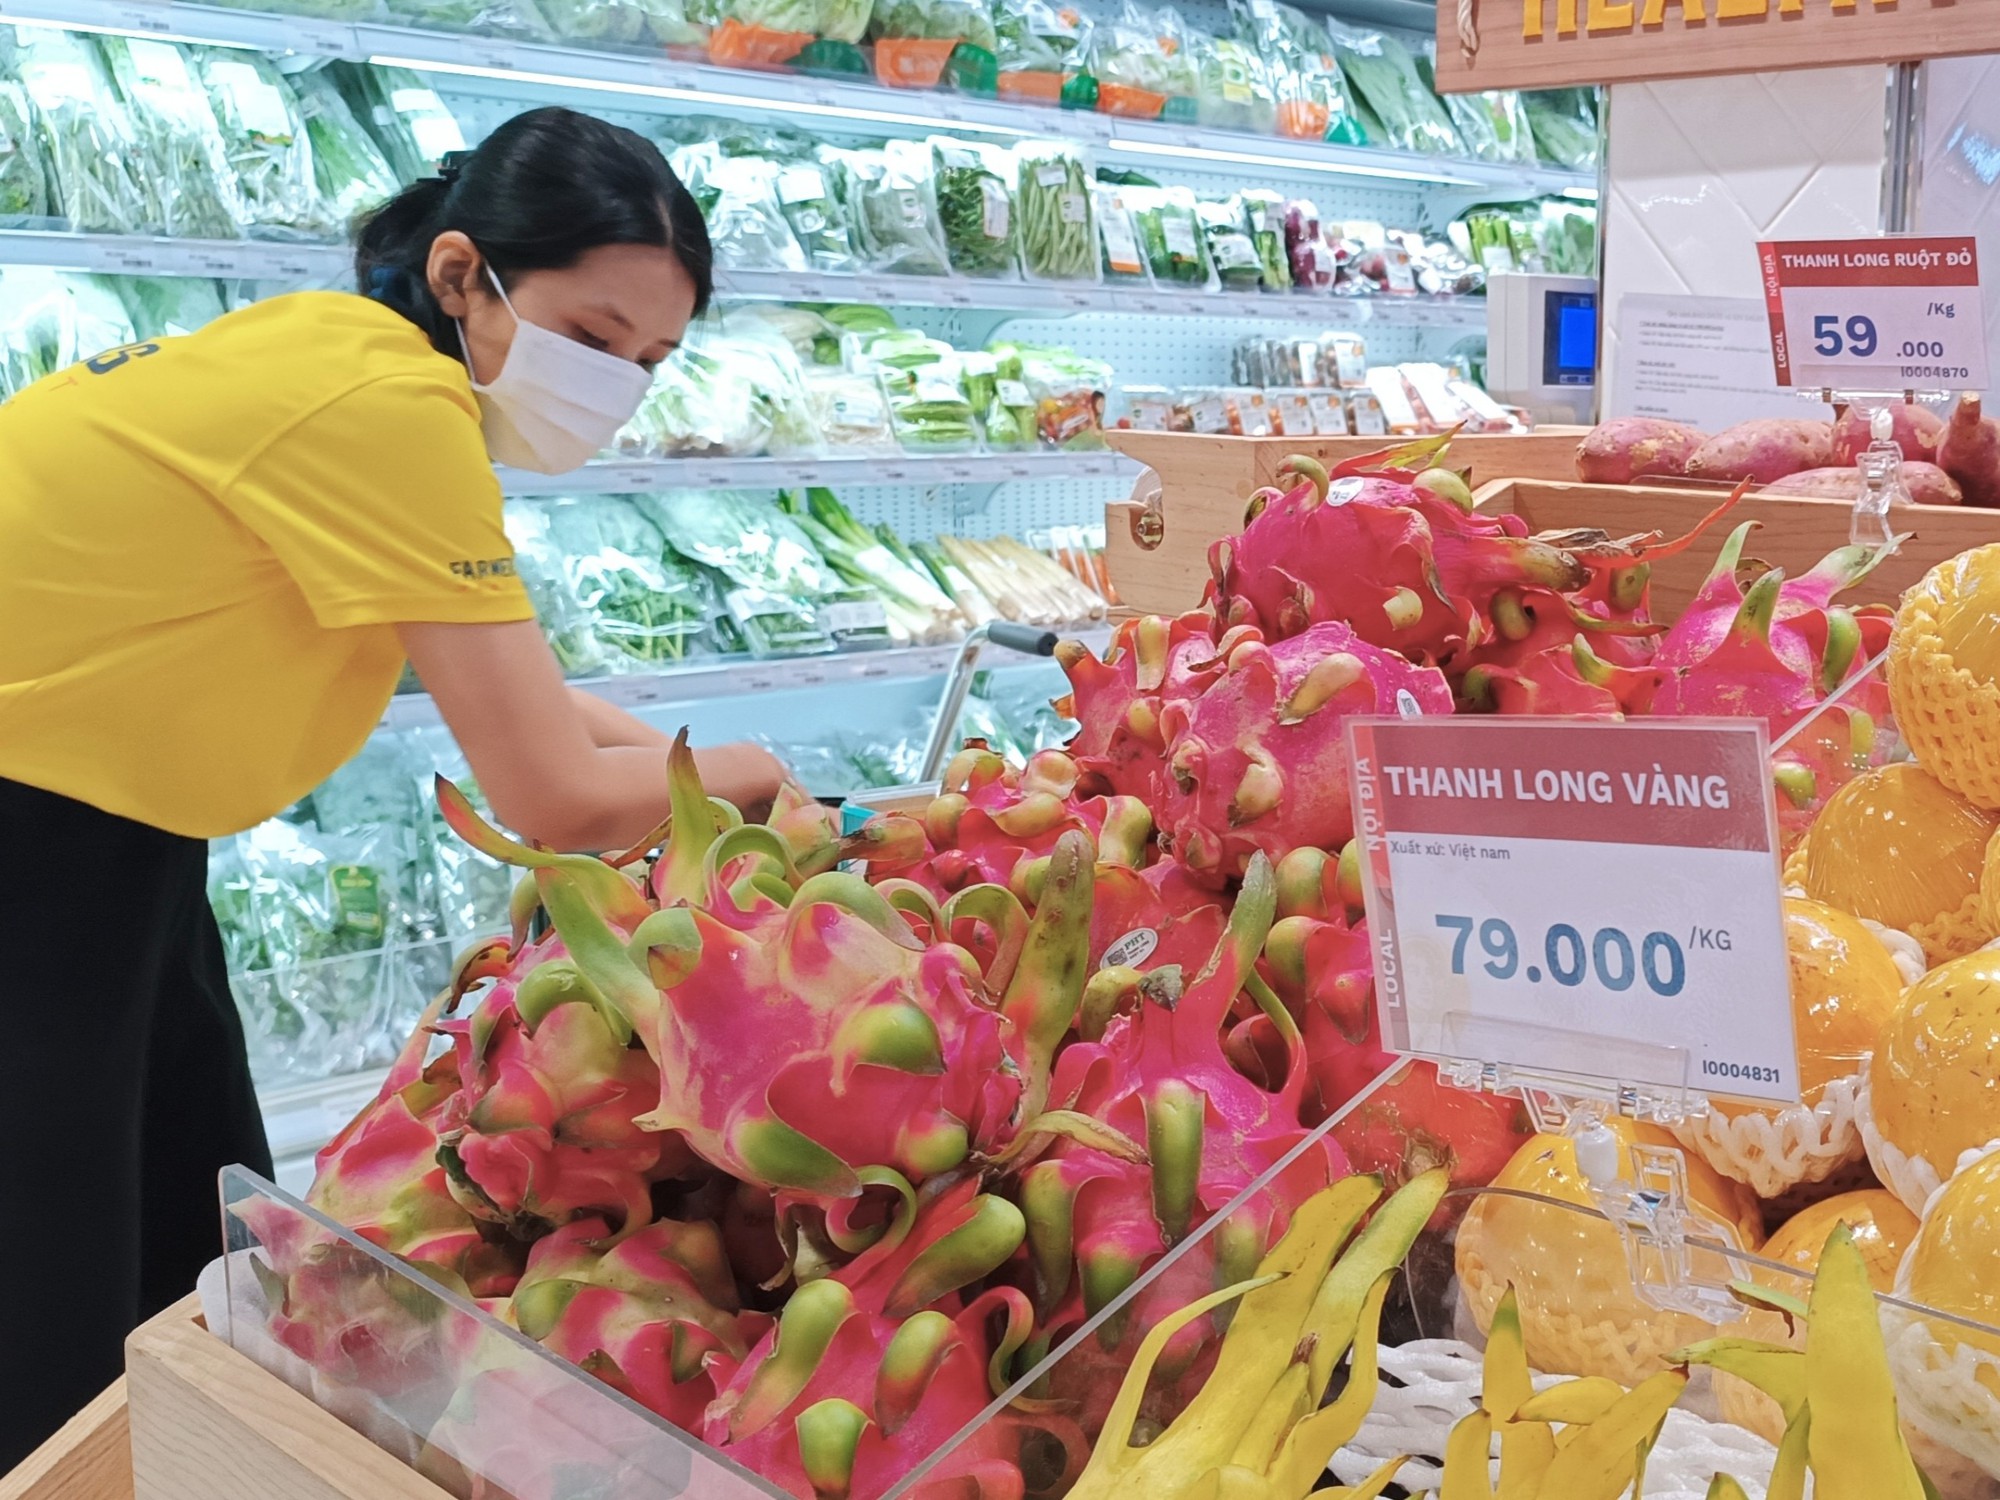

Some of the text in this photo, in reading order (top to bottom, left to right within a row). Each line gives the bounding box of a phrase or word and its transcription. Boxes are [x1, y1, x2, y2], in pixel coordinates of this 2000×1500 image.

[1781, 247, 1972, 270] THANH LONG RUỘT ĐỎ
[1926, 302, 1955, 318] /Kg
[1774, 331, 1787, 368] LOCAL
[1813, 315, 1878, 357] 59
[1383, 763, 1730, 809] THANH LONG VÀNG
[1480, 847, 1511, 860] nam
[1379, 929, 1400, 1008] LOCAL
[1435, 914, 1733, 997] 79.000 /KG
